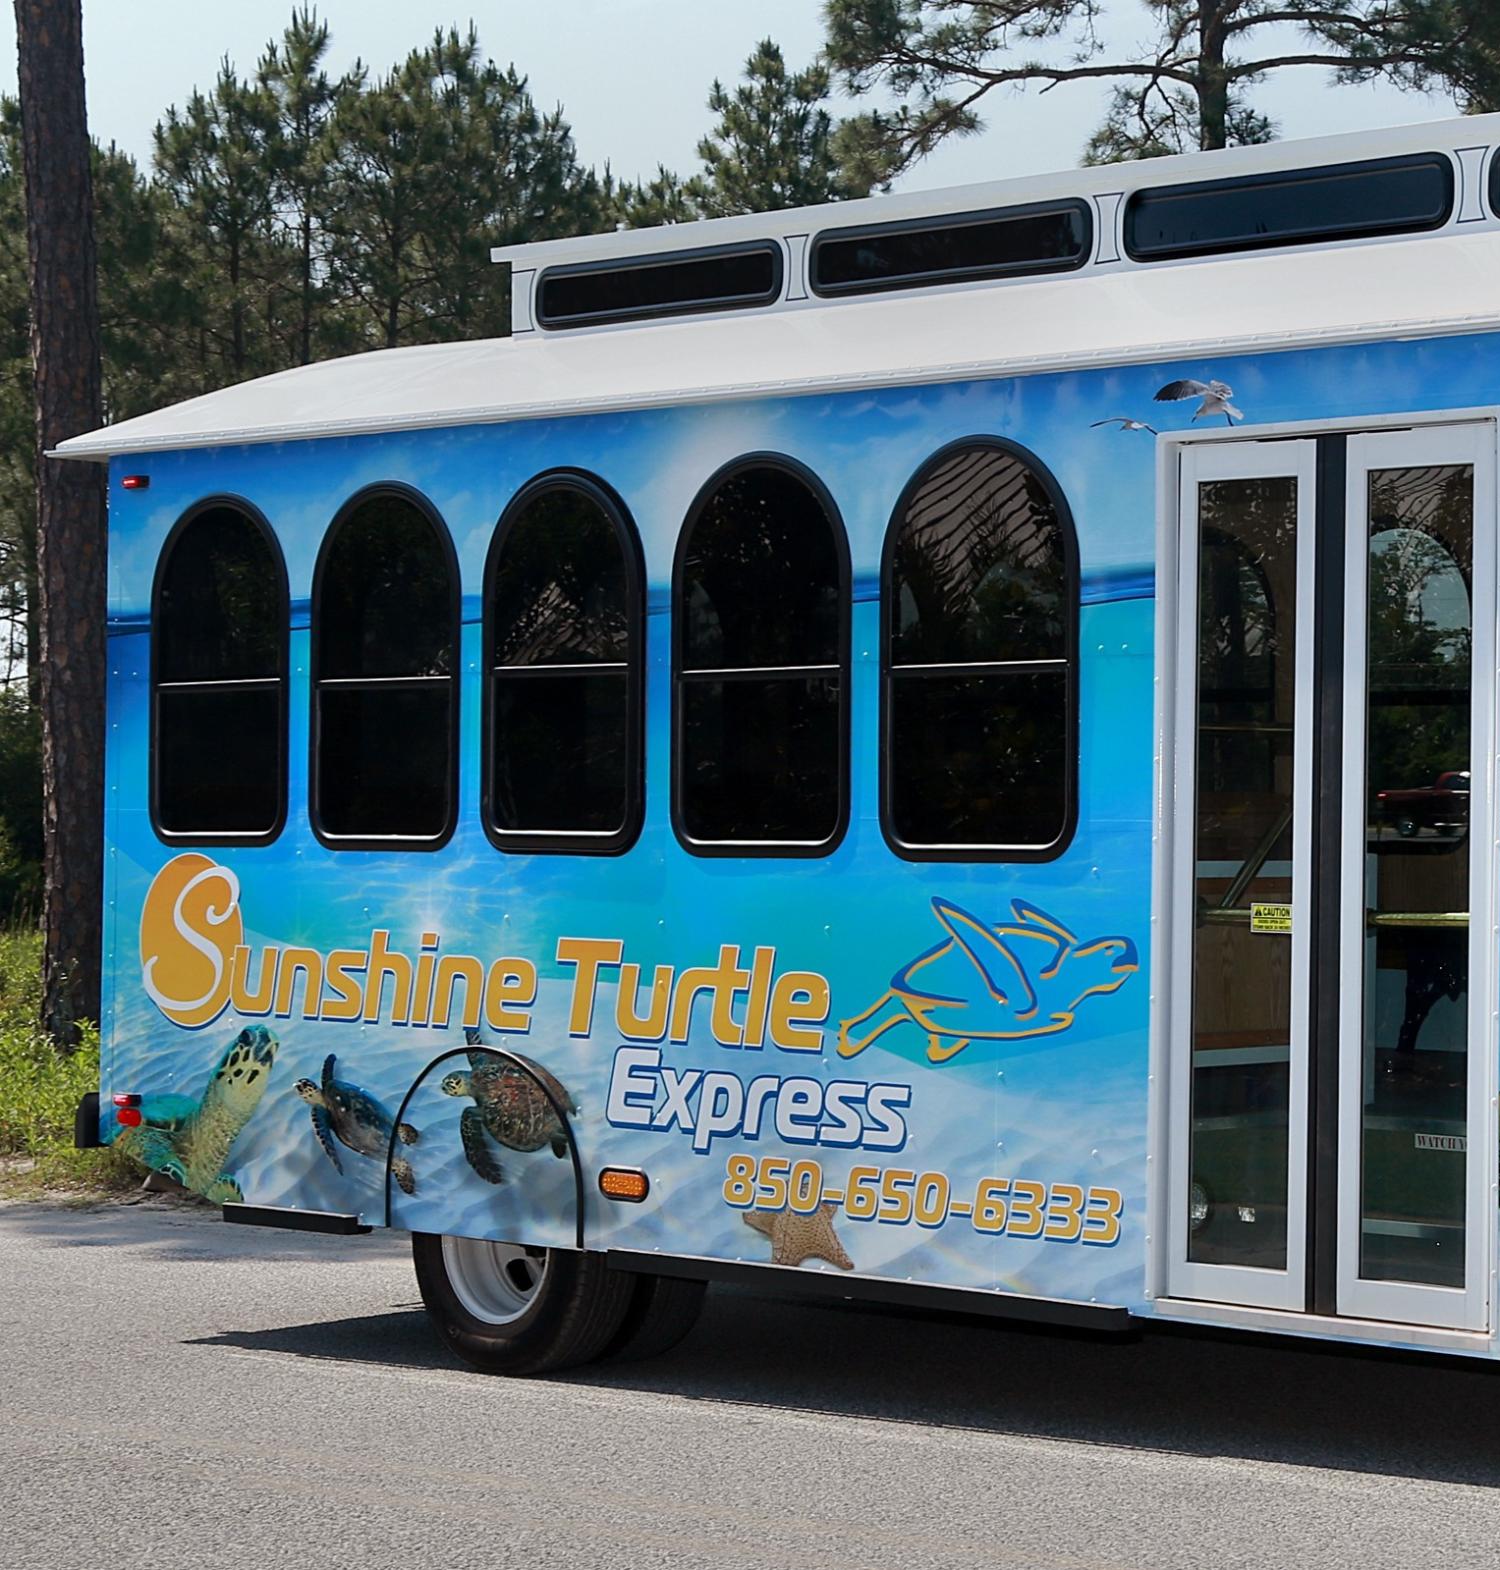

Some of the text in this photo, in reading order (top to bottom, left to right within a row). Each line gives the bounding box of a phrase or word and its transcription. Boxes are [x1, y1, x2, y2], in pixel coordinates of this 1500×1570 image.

[140, 853, 831, 1054] Sunshine Turtle
[1263, 907, 1291, 917] CAUTION
[606, 1045, 911, 1154] Express
[1418, 1135, 1456, 1149] WATCH
[722, 1154, 1124, 1247] 850-650-6333
